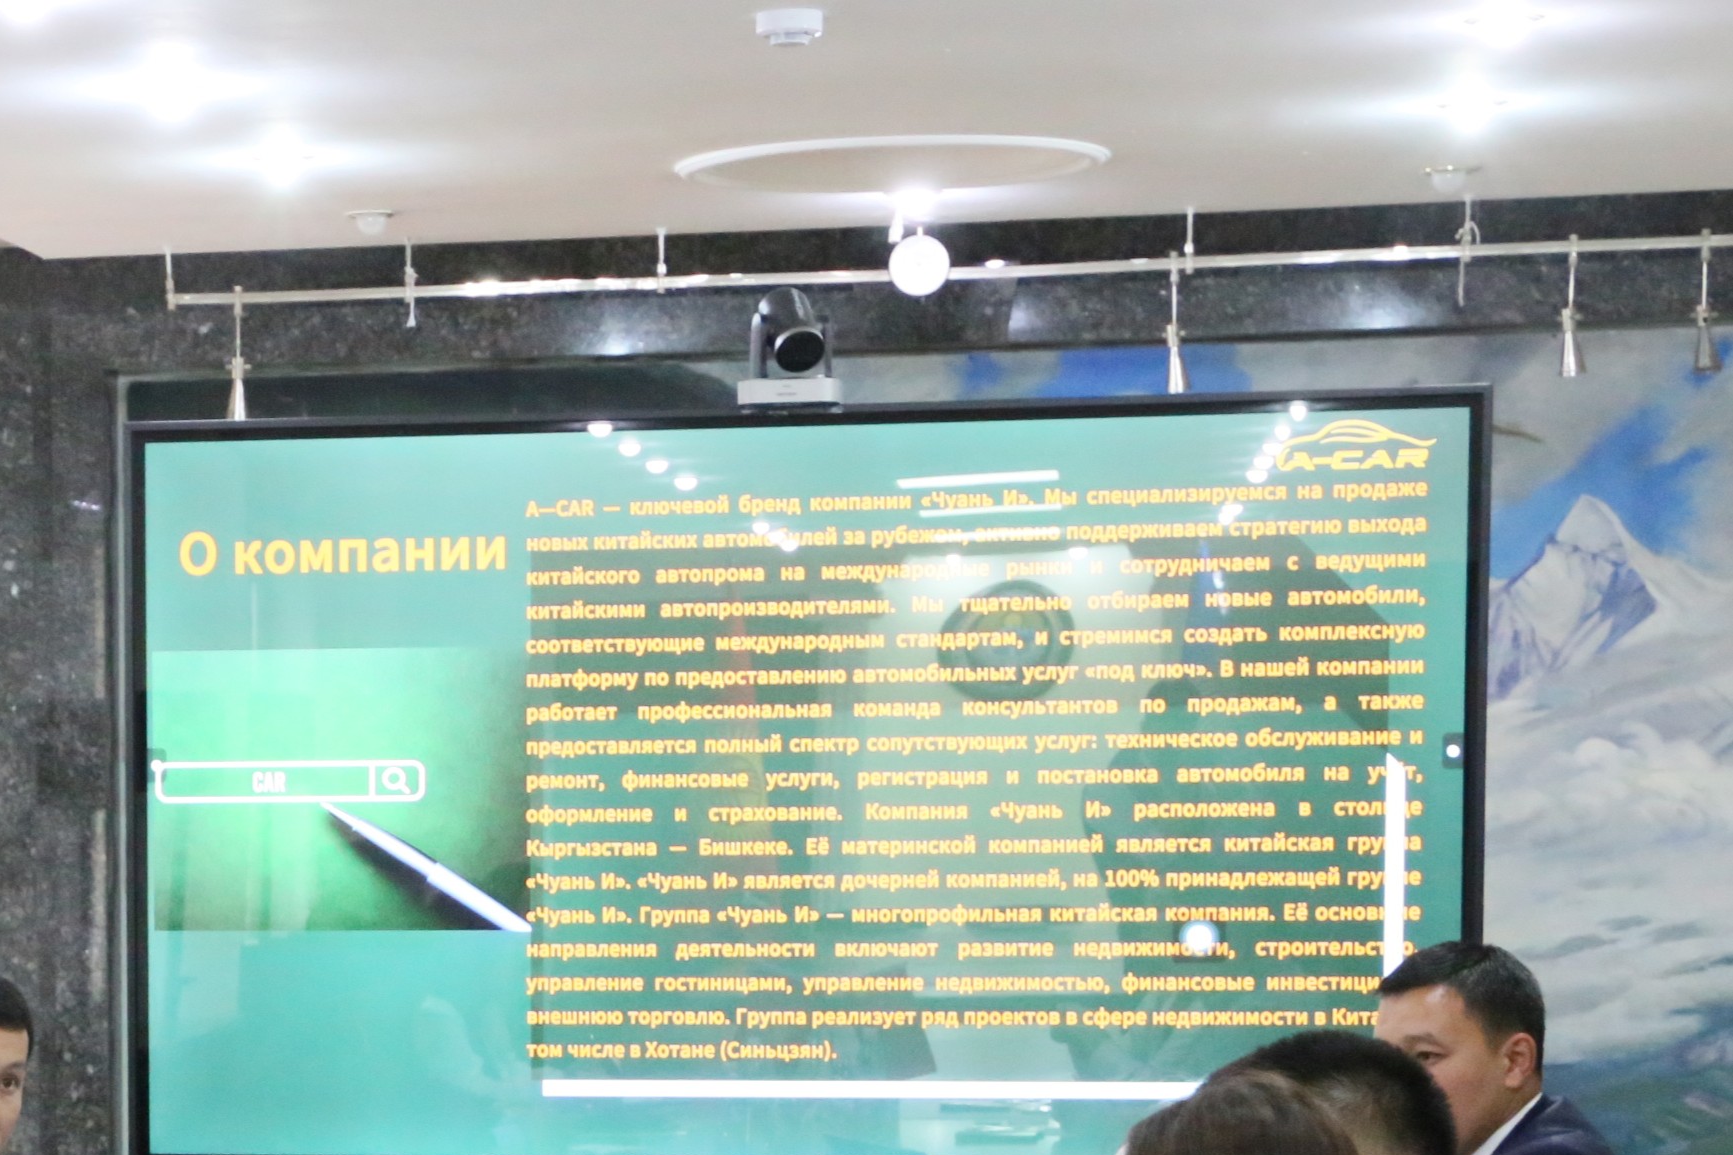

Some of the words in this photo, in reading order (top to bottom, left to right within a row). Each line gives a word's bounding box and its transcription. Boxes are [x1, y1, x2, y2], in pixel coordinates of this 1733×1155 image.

[1276, 447, 1429, 471] A-CAR
[524, 499, 596, 518] A—CAR
[628, 494, 731, 516] ключевой
[738, 493, 803, 515] бренд
[809, 495, 913, 511] компании
[920, 491, 995, 509] «Чуань
[1003, 489, 1036, 506] И».
[1044, 488, 1079, 506] Мы
[1085, 486, 1288, 506] специализируемся
[1296, 484, 1325, 499] на
[1332, 480, 1430, 501] продаже
[525, 537, 588, 552] новых
[593, 531, 697, 550] китайских
[703, 527, 838, 549] автомоилей
[844, 531, 866, 545] за
[1066, 524, 1224, 543] поддерживаем
[1229, 519, 1344, 539] стратегию
[1348, 516, 1430, 535] выхода
[179, 531, 218, 576] О
[234, 535, 506, 575] компании
[526, 568, 642, 587] китайского
[655, 567, 767, 584] автопрома
[780, 566, 808, 581] на
[1006, 560, 1072, 581] рынки
[1090, 560, 1104, 574] и
[1119, 556, 1272, 577] сотрудничаем
[1286, 556, 1300, 571] с
[1314, 552, 1428, 572] ведущими
[525, 601, 647, 621] китайскими
[660, 599, 896, 619] автопроизводителями.
[912, 596, 943, 612] Мы
[959, 595, 1072, 615] тщательно
[1087, 590, 1190, 611] отбираем
[1205, 590, 1275, 608] новые
[1287, 586, 1429, 607] автомобили,
[525, 637, 705, 655] соответствующие
[716, 635, 886, 652] международным
[897, 632, 1023, 649] стандартам,
[1036, 631, 1050, 645] и
[1059, 628, 1174, 646] стремимся
[1183, 627, 1270, 645] создать
[1278, 622, 1429, 643] комплексную
[524, 671, 640, 690] платформу
[643, 672, 671, 686] по
[675, 670, 849, 687] предоставлению
[852, 665, 1017, 683] автомобильных
[1022, 665, 1078, 683] услуг
[1085, 665, 1137, 681] «под
[1142, 664, 1214, 679] ключ».
[1220, 660, 1235, 677] В
[1240, 657, 1312, 677] нашей
[1315, 659, 1427, 677] компании
[524, 704, 619, 725] работает
[637, 703, 833, 723] профессиональная
[853, 702, 943, 718] команда
[962, 700, 1120, 718] консультантов
[1140, 698, 1168, 714] по
[1187, 696, 1304, 716] продажам,
[1324, 695, 1337, 710] а
[1357, 693, 1427, 711] также
[524, 739, 698, 759] предоставляется
[704, 736, 784, 753] полный
[789, 737, 861, 755] спектр
[866, 736, 1029, 754] сопутствующих
[1035, 734, 1097, 754] услуг:
[1105, 732, 1240, 749] техническое
[1244, 728, 1404, 750] обслуживание
[1409, 729, 1423, 744] и
[251, 771, 286, 793] CAR
[524, 774, 608, 793] ремонт,
[620, 770, 749, 792] финансовые
[766, 772, 841, 790] услуги,
[856, 771, 990, 789] регистрация
[1006, 771, 1020, 784] и
[1037, 768, 1162, 784] постановка
[1175, 763, 1308, 784] автомобиля
[1322, 765, 1352, 783] на
[1367, 762, 1424, 784] ут,
[524, 806, 655, 825] оформление
[674, 807, 689, 822] и
[708, 806, 844, 824] страхование.
[864, 803, 970, 820] Компания
[990, 802, 1064, 822] «Чуань
[1084, 801, 1113, 818] И»
[1132, 801, 1277, 822] расположена
[1299, 802, 1312, 816] в
[1332, 800, 1426, 817] столе
[524, 839, 659, 859] Кыргызстана
[698, 839, 793, 856] Бишкеке.
[805, 836, 831, 856] Её
[840, 835, 978, 856] материнской
[988, 833, 1105, 854] компанией
[1116, 837, 1214, 853] является
[1223, 832, 1337, 853] китайская
[1346, 834, 1425, 855] груа
[524, 874, 596, 893] «Чуань
[600, 873, 631, 891] И».
[638, 873, 706, 893] «Чуань
[713, 873, 740, 889] И»
[744, 874, 836, 890] является
[840, 870, 940, 892] дочерней
[946, 869, 1069, 889] компанией,
[1072, 873, 1100, 887] на
[1105, 869, 1161, 887] 100%
[1165, 867, 1342, 890] принадлежащей
[1346, 869, 1424, 889] груе
[524, 906, 595, 927] «Чуань
[602, 906, 635, 924] И».
[638, 906, 712, 927] Группа
[716, 907, 789, 927] «Чуань
[794, 906, 821, 923] И»
[851, 906, 1044, 925] многопрофильная
[1048, 905, 1160, 922] китайская
[1165, 906, 1277, 923] компания.
[1282, 903, 1310, 922] Её
[1314, 905, 1424, 922] основе
[526, 942, 659, 960] направления
[674, 943, 817, 960] деятельности
[834, 942, 939, 958] включают
[957, 942, 1056, 960] развитие
[1254, 940, 1418, 959] строительсто
[524, 975, 646, 997] управление
[653, 976, 794, 993] гостиницами,
[802, 976, 925, 995] управление
[935, 976, 1112, 993] недвижимостью,
[1121, 973, 1257, 994] финансовые
[1266, 975, 1382, 994] инвестици
[525, 1008, 624, 1027] внешнюю
[628, 1010, 731, 1028] торговлю.
[736, 1009, 807, 1028] Группа
[811, 1010, 916, 1030] реализует
[920, 1010, 960, 1030] ряд
[964, 1011, 1060, 1029] проектов
[1065, 1011, 1080, 1027] в
[1083, 1008, 1148, 1030] сфере
[1152, 1010, 1310, 1030] недвижимости
[1314, 1011, 1327, 1025] в
[1332, 1008, 1379, 1026] Кита
[525, 1042, 563, 1060] том
[567, 1044, 625, 1060] числе
[630, 1043, 641, 1058] в
[645, 1042, 716, 1059] Хотане
[720, 1041, 839, 1062] (Синьцзян).
